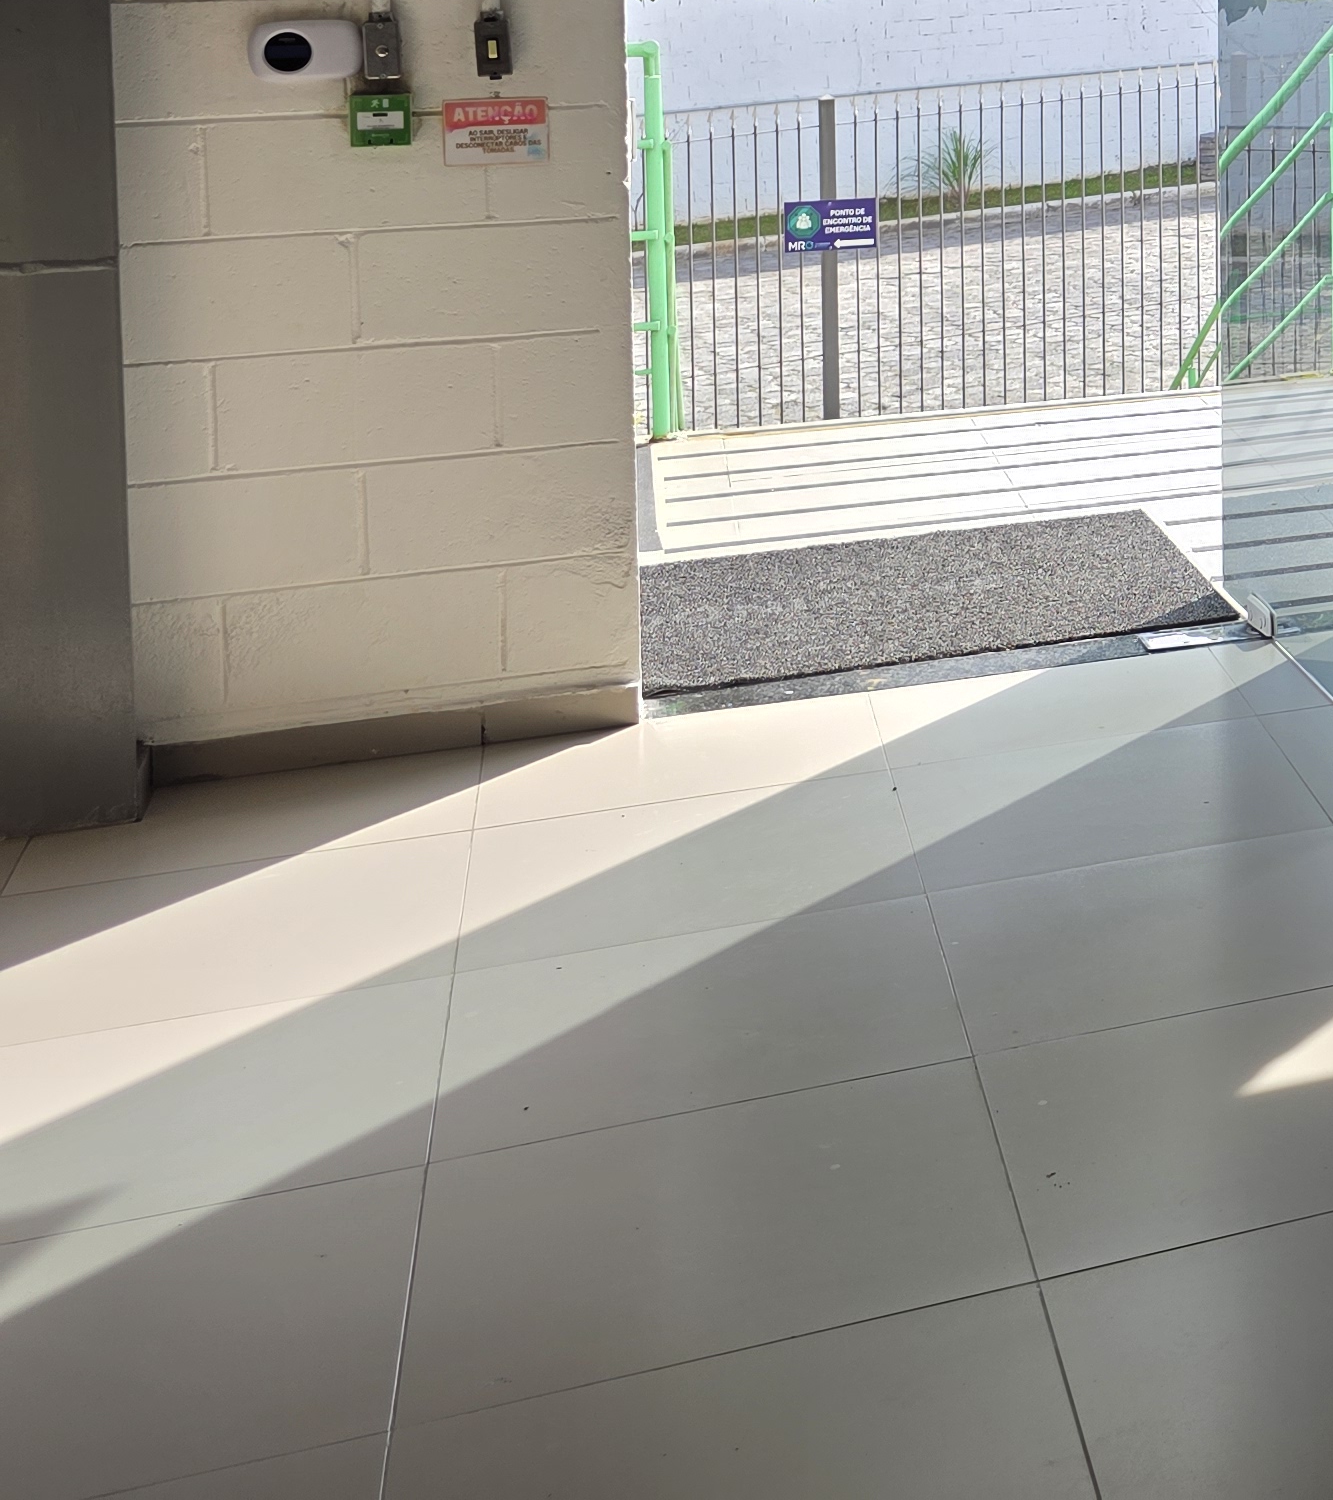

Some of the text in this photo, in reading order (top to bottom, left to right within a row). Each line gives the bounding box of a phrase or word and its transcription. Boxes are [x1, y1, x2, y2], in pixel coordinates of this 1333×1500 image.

[453, 102, 538, 124] ATENÇÃO
[455, 141, 504, 149] DESCONECTAR
[830, 207, 866, 217] PONTO DE
[822, 217, 862, 226] ENCONTRO
[824, 225, 871, 235] EMERGÊNCIA
